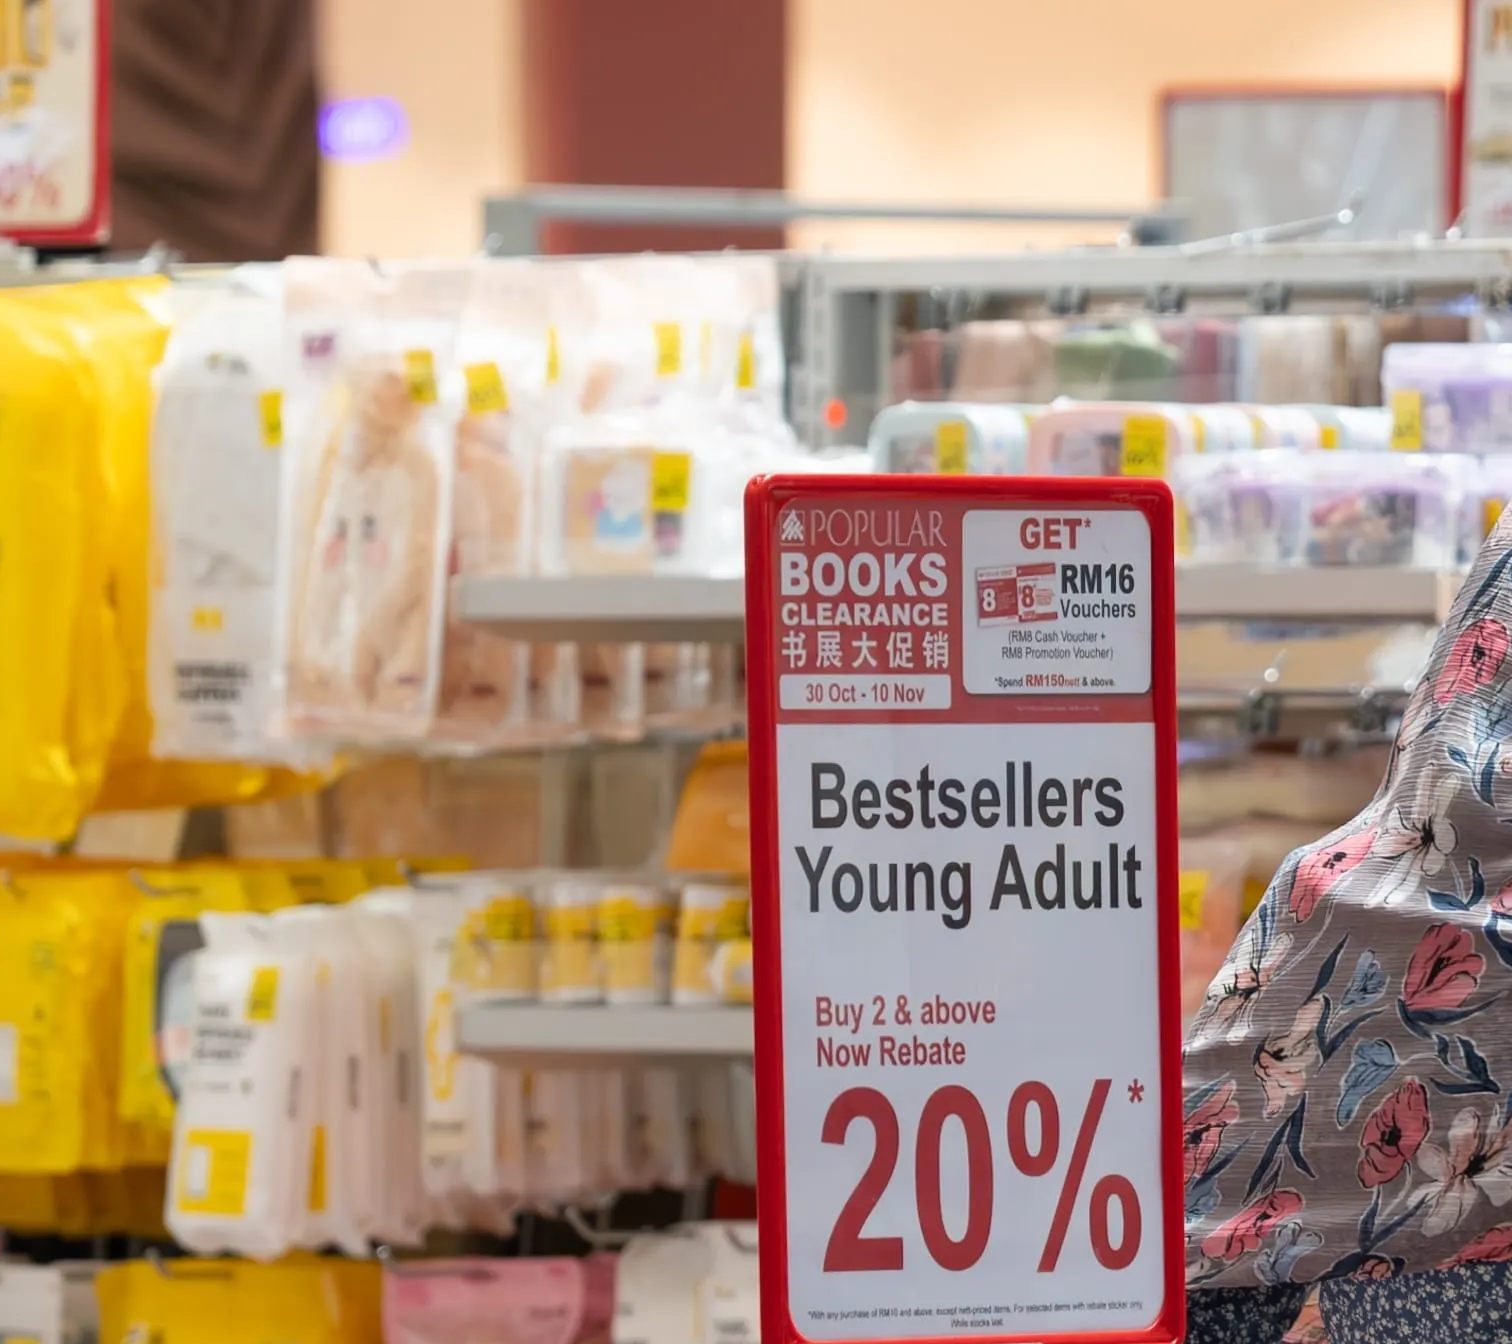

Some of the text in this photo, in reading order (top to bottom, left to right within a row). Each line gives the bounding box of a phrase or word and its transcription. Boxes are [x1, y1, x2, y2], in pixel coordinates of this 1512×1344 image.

[810, 509, 948, 547] POPULAR
[780, 552, 948, 597] BOOKS
[1061, 563, 1135, 595] RM16
[781, 602, 949, 626] CLEARANCE
[1060, 599, 1136, 619] Vouchers
[781, 630, 949, 669] 书展大促销
[806, 683, 824, 703] 30
[828, 682, 857, 703] Oct
[871, 683, 888, 703] 10
[894, 683, 925, 703] Nov
[811, 761, 1125, 829] Bestsellers
[794, 843, 1143, 930] Young Adult
[816, 994, 996, 1034] Buy 2 & above
[816, 1035, 966, 1067] Now Rebate
